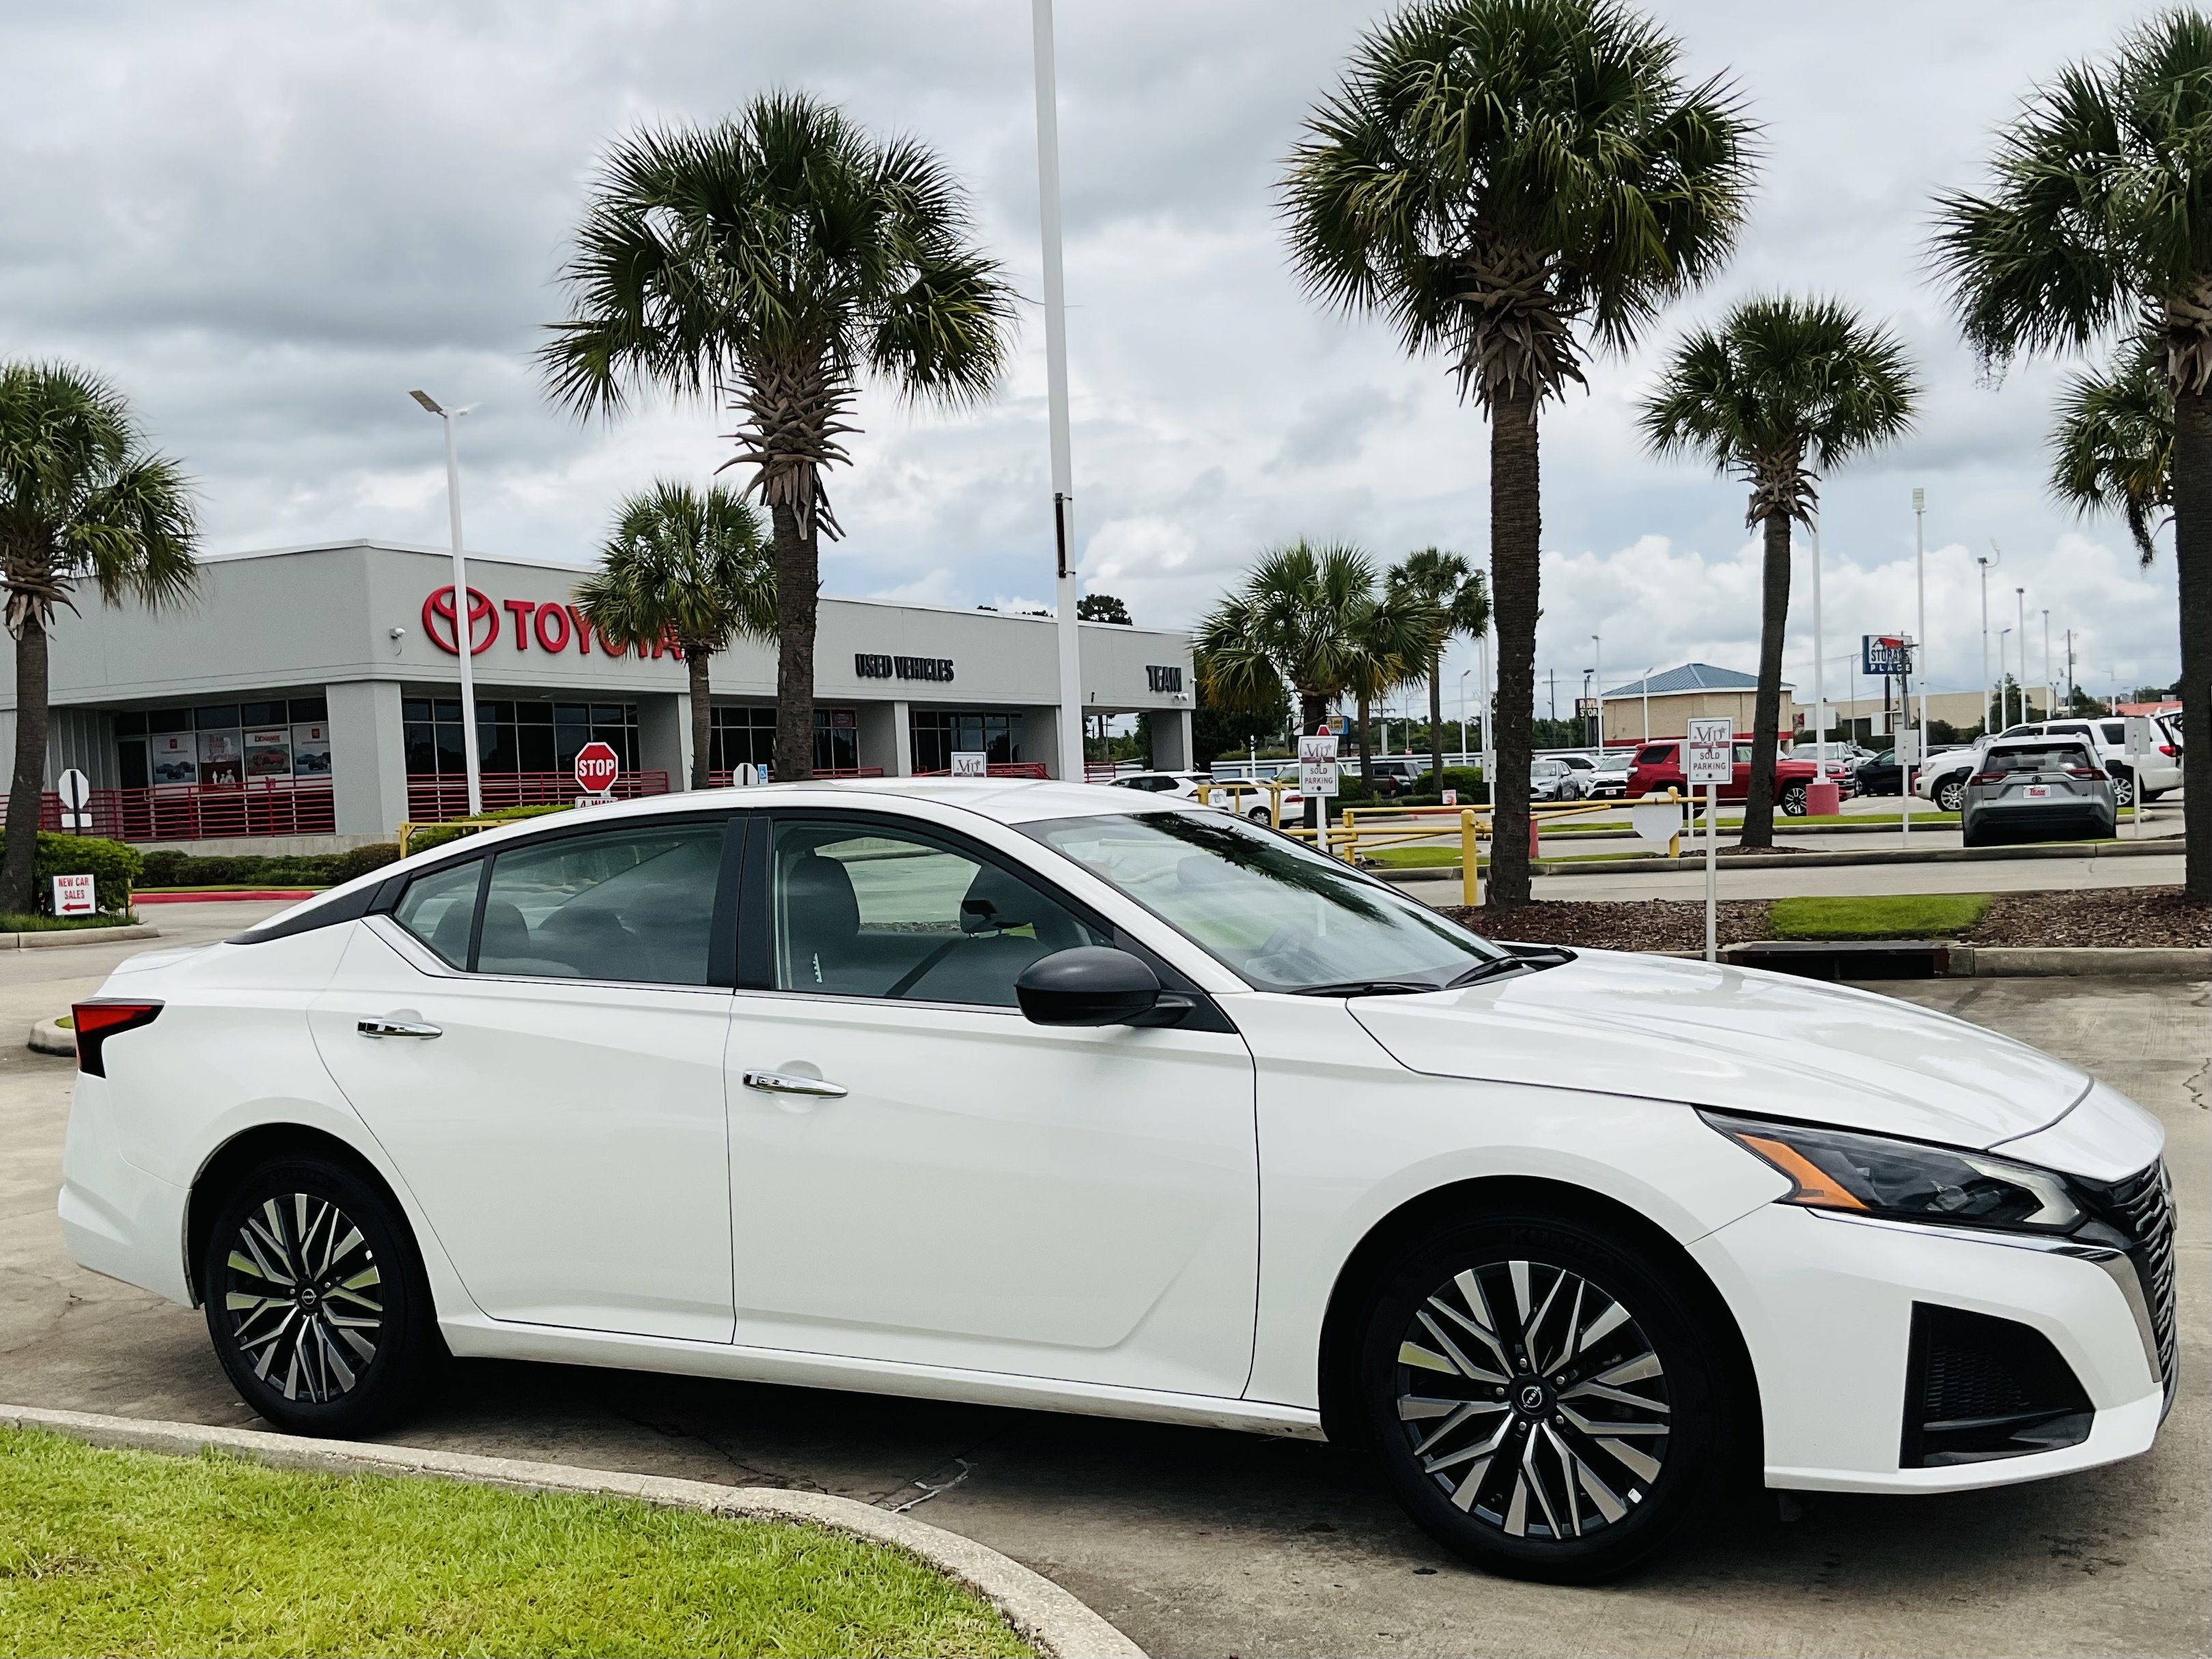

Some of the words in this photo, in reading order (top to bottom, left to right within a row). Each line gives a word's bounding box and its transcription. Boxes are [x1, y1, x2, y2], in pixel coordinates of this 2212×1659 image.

[504, 599, 683, 660] TOYOA
[1871, 649, 1910, 662] STORA
[855, 653, 893, 678] USED
[893, 656, 954, 682] VEHICLES
[1145, 665, 1182, 693] TEAM
[1700, 752, 1720, 760] SOLD
[578, 759, 615, 777] STOP
[1693, 762, 1726, 770] PARKING
[58, 878, 73, 887] NEW
[75, 876, 89, 887] CAR
[64, 889, 85, 900] SALES
